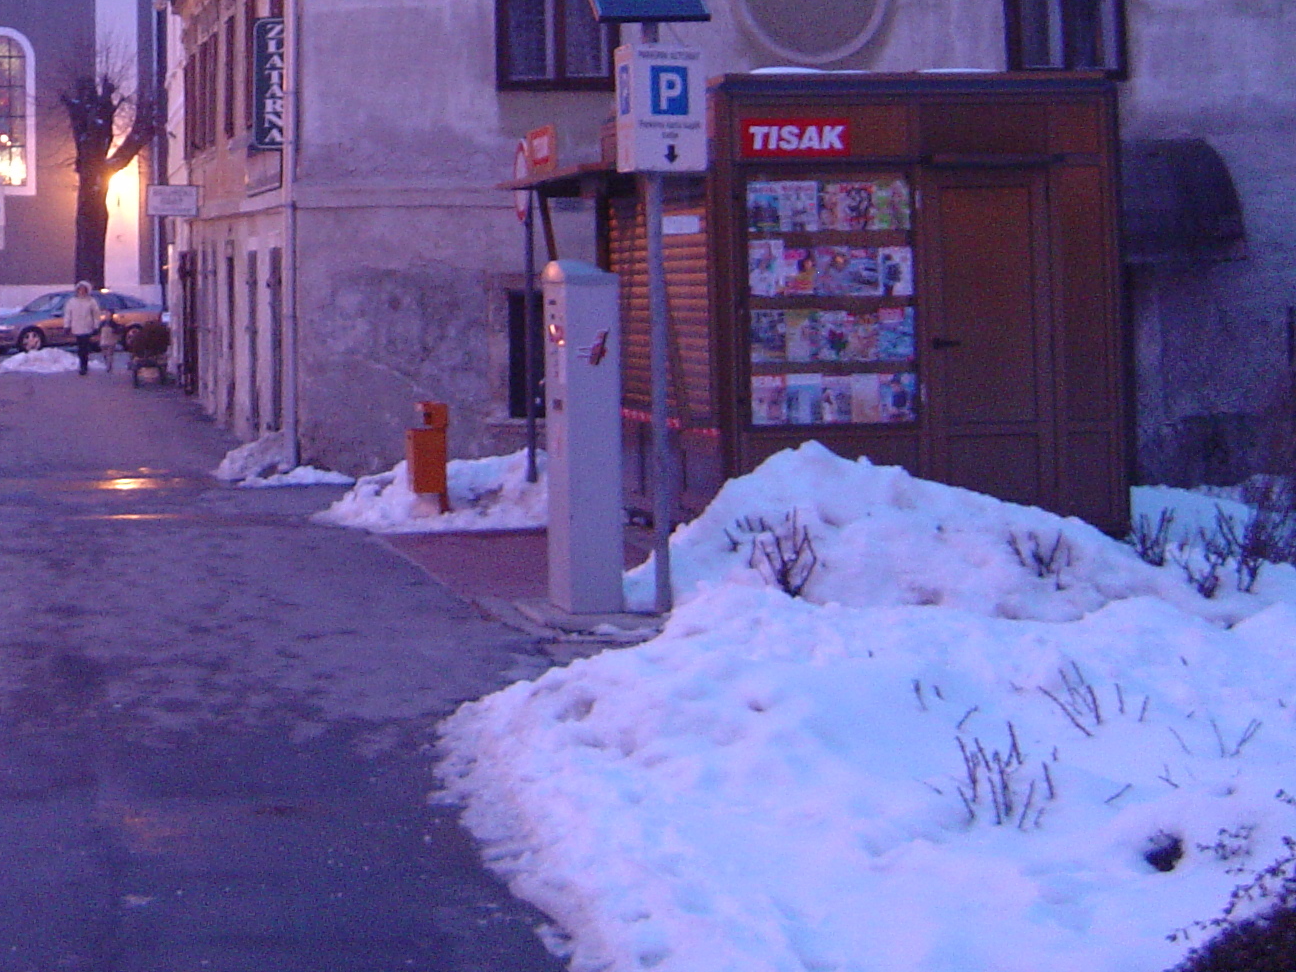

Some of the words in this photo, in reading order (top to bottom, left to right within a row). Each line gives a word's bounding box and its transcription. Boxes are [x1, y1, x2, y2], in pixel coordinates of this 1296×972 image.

[264, 23, 284, 143] ZLATARNA
[659, 71, 683, 110] P
[748, 125, 845, 151] TISAK
